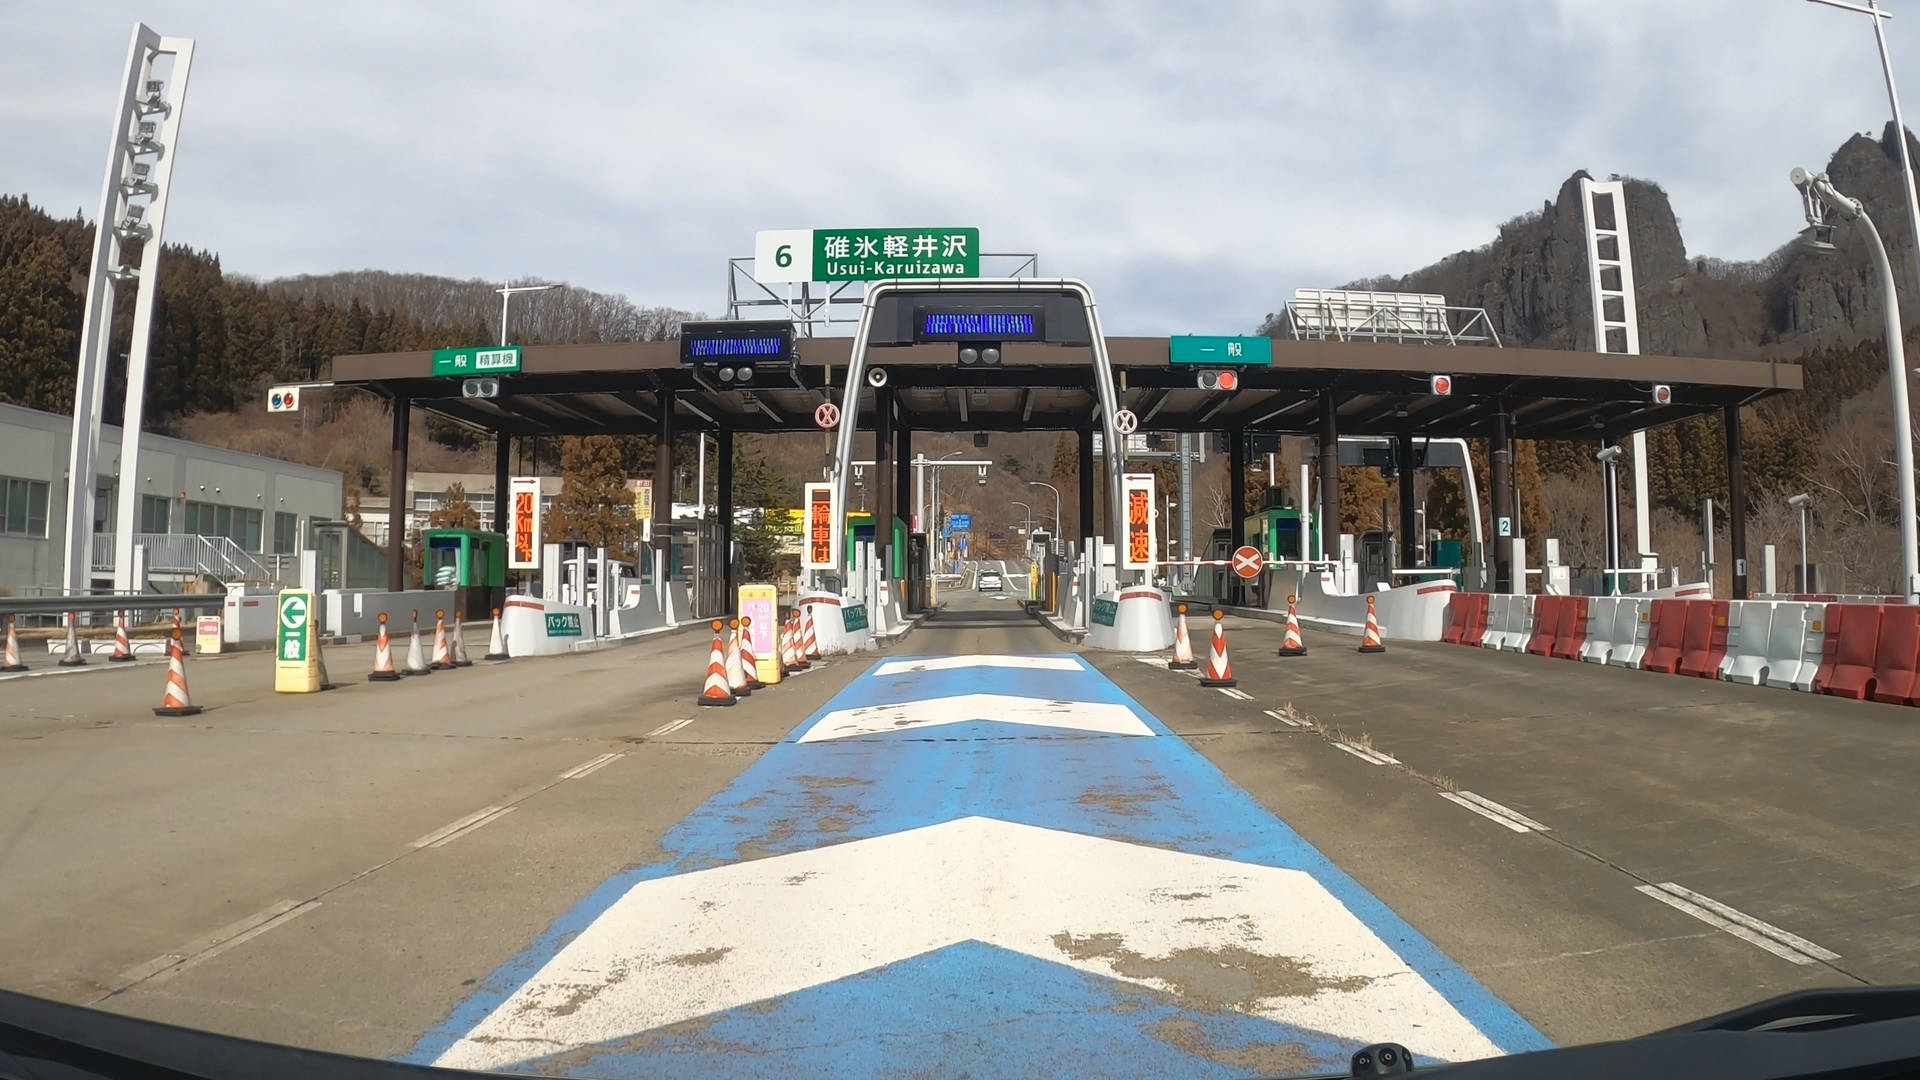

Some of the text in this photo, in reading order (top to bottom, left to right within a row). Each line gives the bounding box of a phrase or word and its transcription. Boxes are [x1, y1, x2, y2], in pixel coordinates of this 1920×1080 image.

[775, 234, 968, 268] 6 碓氷軽井沢
[826, 261, 965, 276] Usui-Karuizawa
[438, 354, 468, 368] 一般
[1199, 342, 1243, 357] 一般
[811, 490, 831, 563] 二輪車は
[1129, 491, 1149, 562] 減速
[283, 631, 301, 659] 一般
